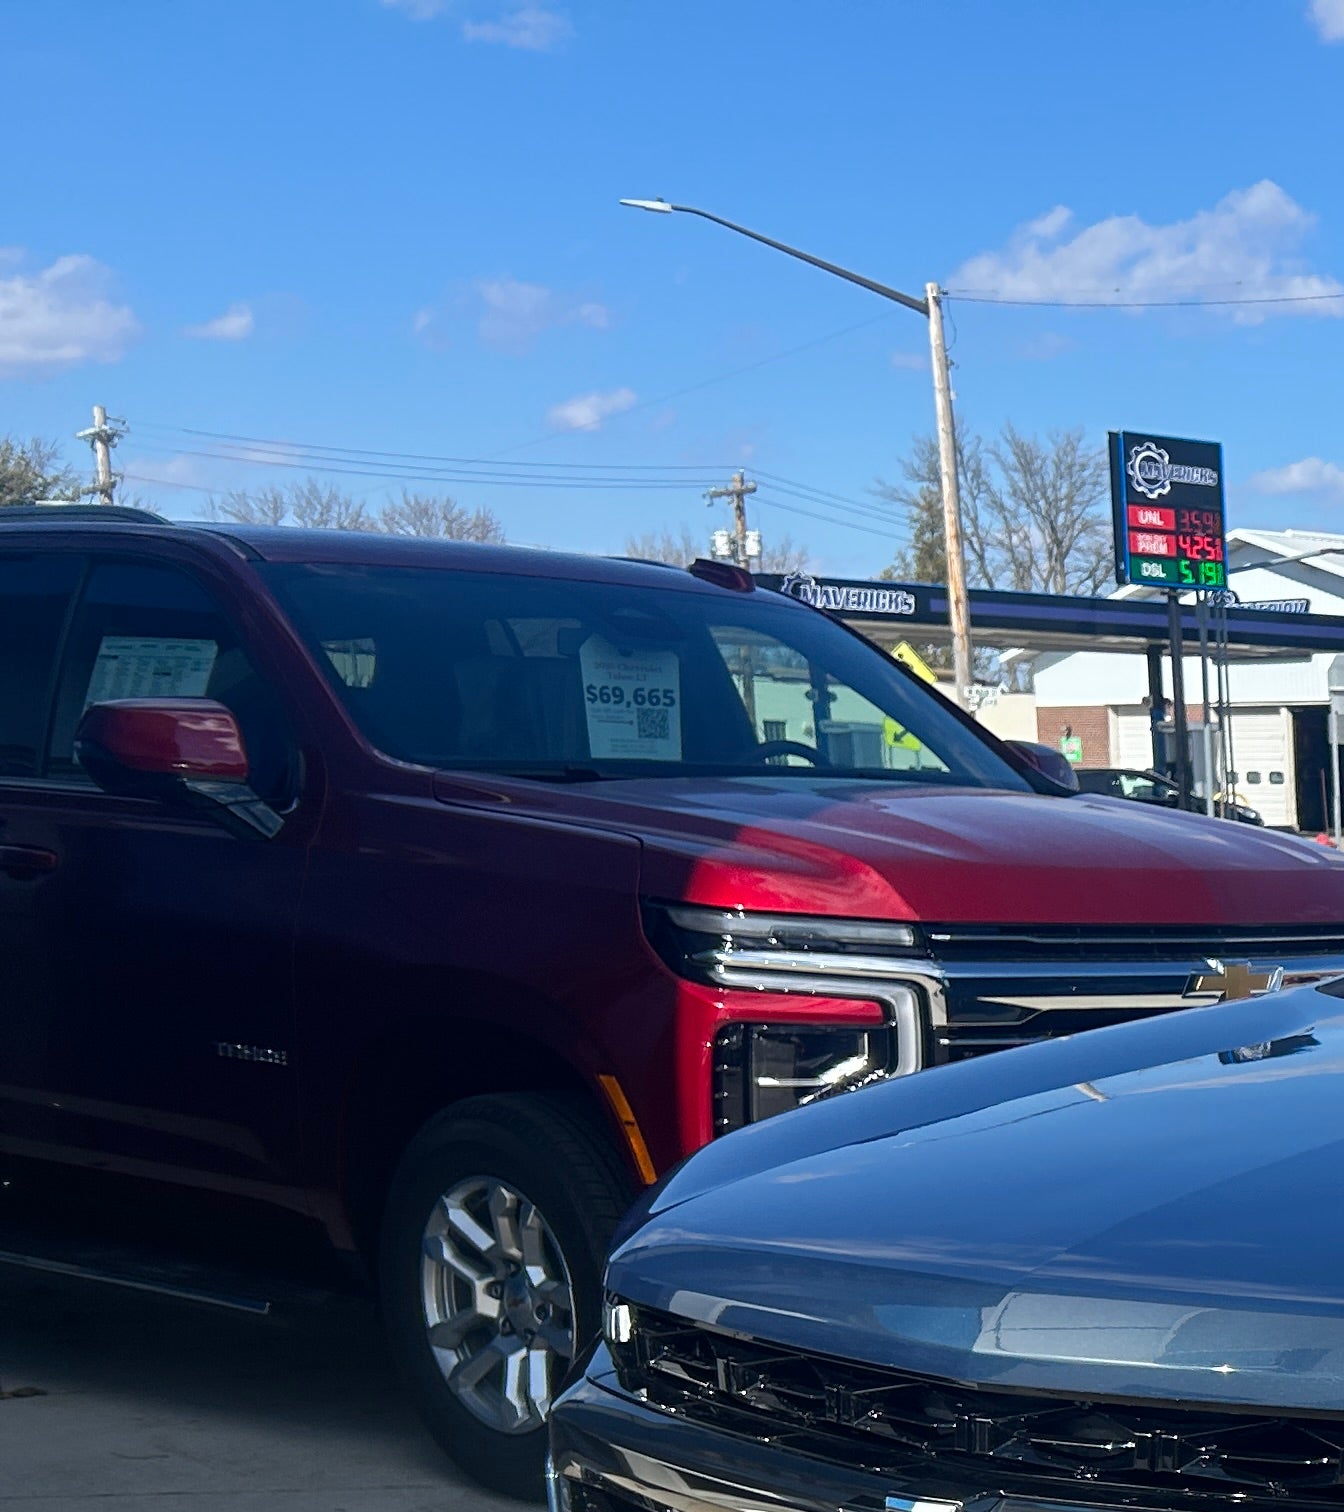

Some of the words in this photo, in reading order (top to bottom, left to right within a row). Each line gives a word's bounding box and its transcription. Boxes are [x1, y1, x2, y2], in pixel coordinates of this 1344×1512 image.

[1137, 509, 1164, 526] UNL
[1141, 562, 1166, 578] DSL
[586, 684, 676, 708] $69,665
